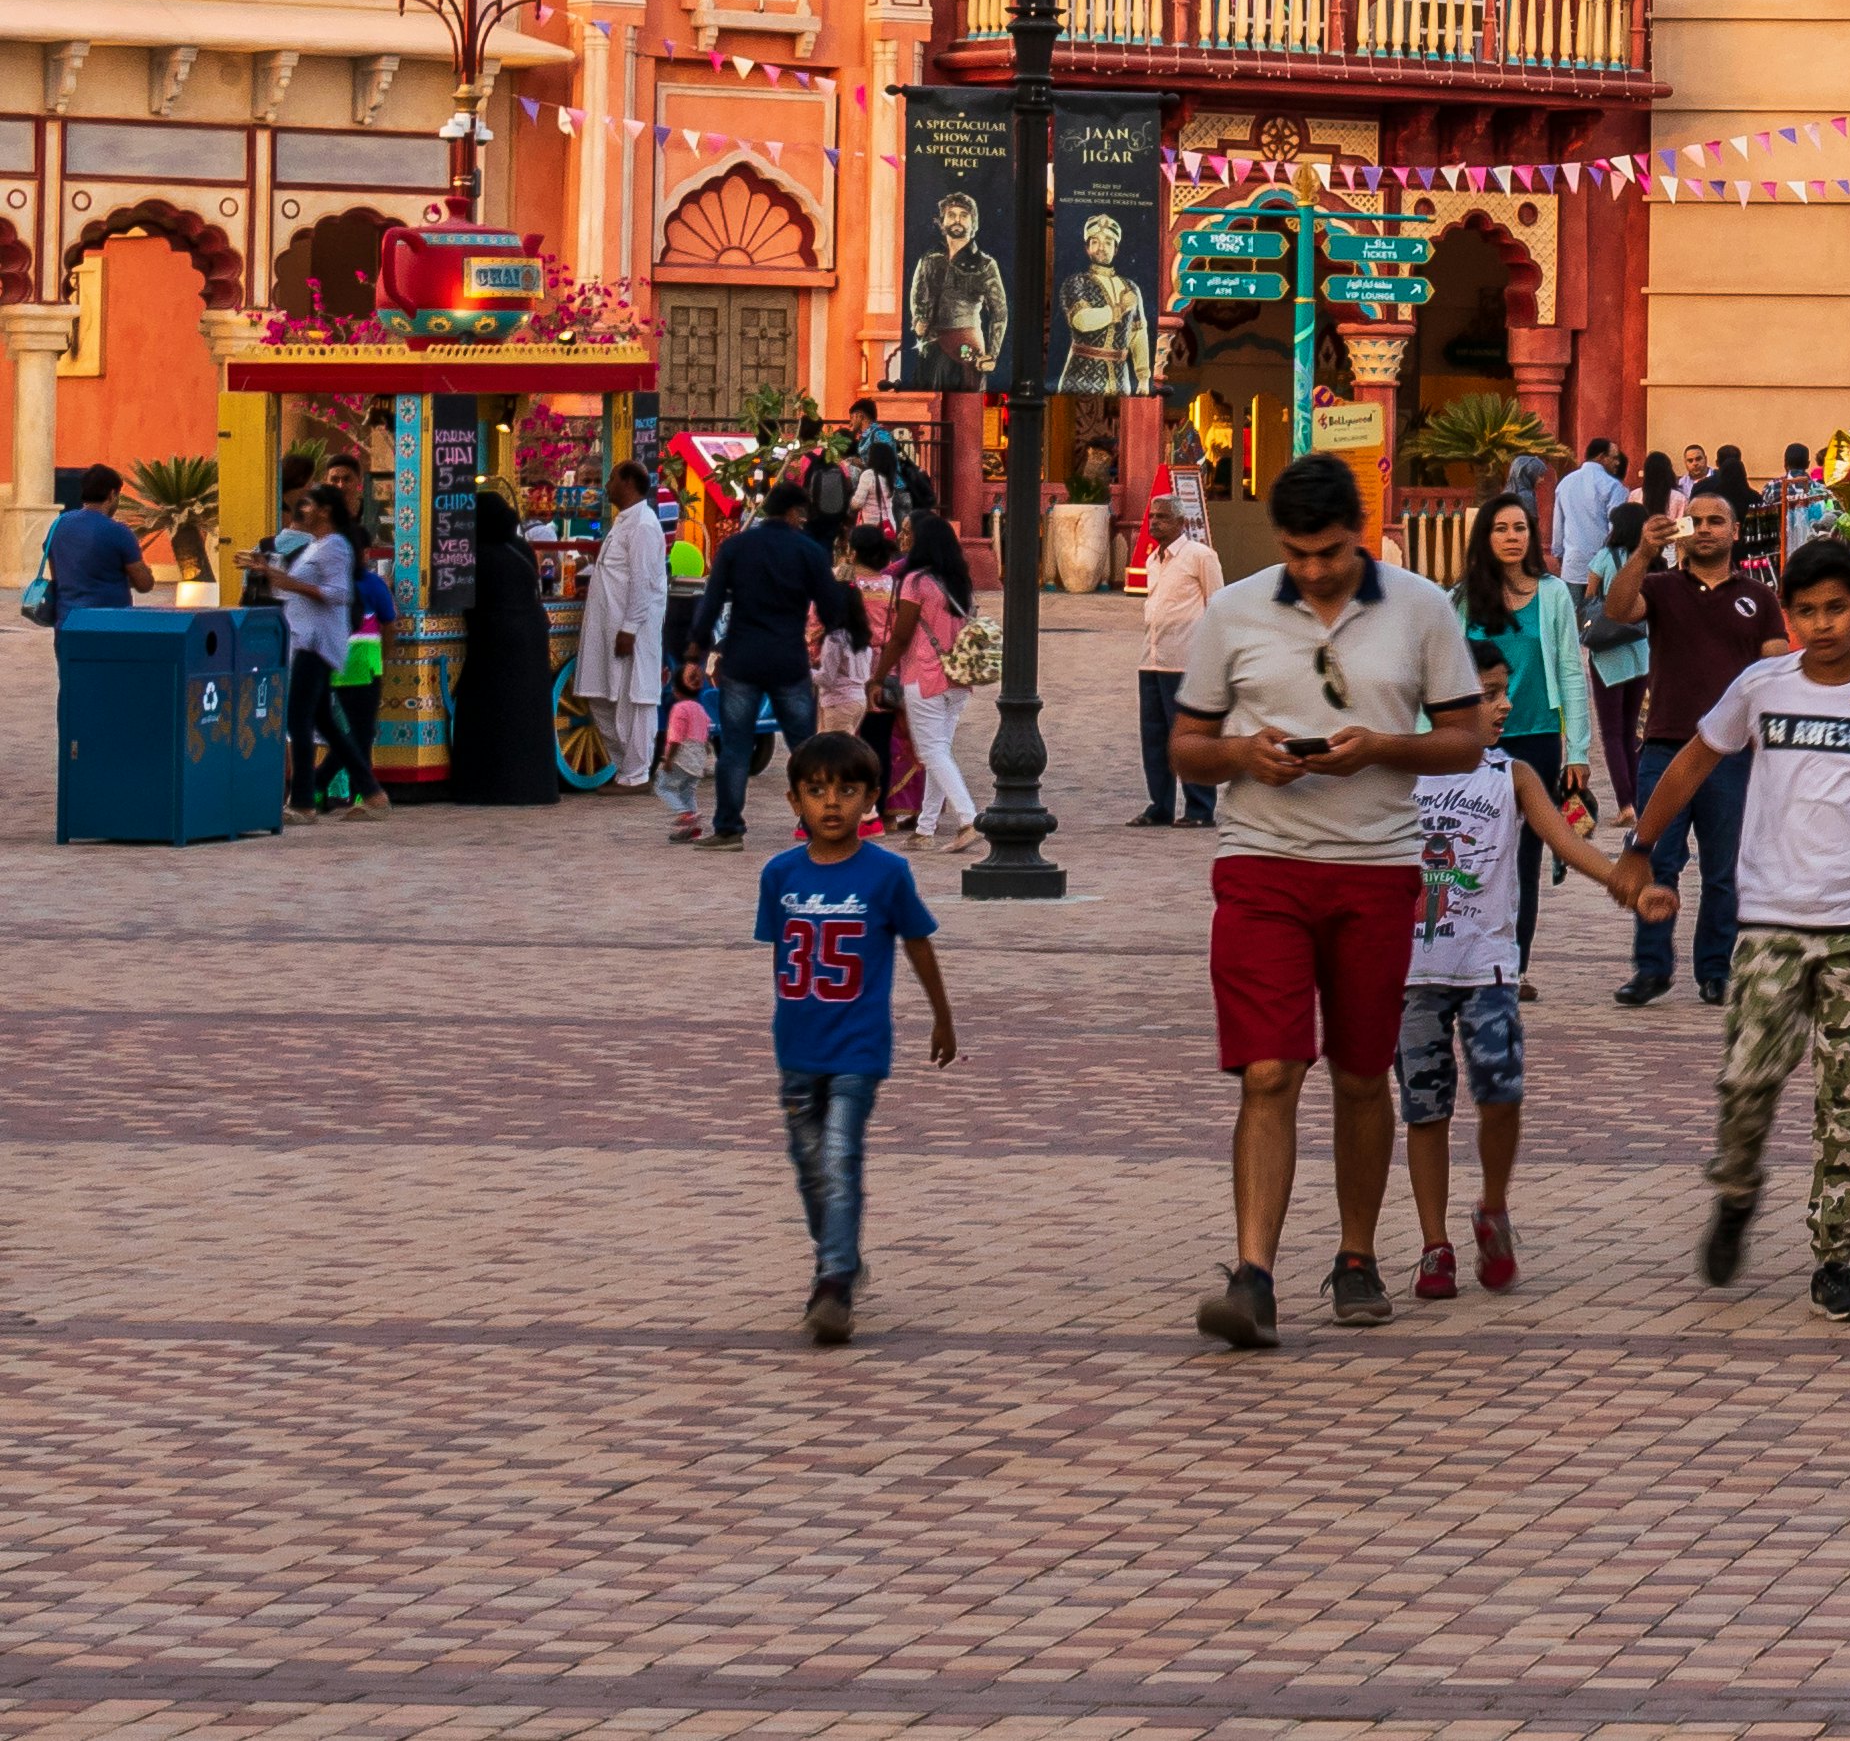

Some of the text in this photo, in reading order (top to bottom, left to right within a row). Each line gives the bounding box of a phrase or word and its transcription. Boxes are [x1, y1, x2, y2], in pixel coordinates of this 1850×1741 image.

[914, 120, 1006, 132] A SPECTACULAR
[975, 134, 990, 144] AT
[1084, 126, 1129, 141] JAAN
[914, 145, 1006, 157] A SPECTACULAR
[1082, 150, 1133, 164] JIGAR
[944, 158, 979, 168] PRICE
[1210, 234, 1244, 246] ROCK
[1362, 249, 1398, 259] TICKETS
[476, 267, 521, 288] CHAI
[1215, 287, 1233, 295] ATM
[1345, 291, 1395, 301] VIP LOUNGE
[435, 429, 476, 443] KARAK
[435, 446, 473, 465] CHAI
[438, 467, 453, 488] 5
[434, 493, 476, 510] CHIPS
[437, 513, 451, 532] 5
[438, 539, 469, 552] VEG
[1435, 788, 1500, 819] Machine
[777, 918, 867, 1002] 35
